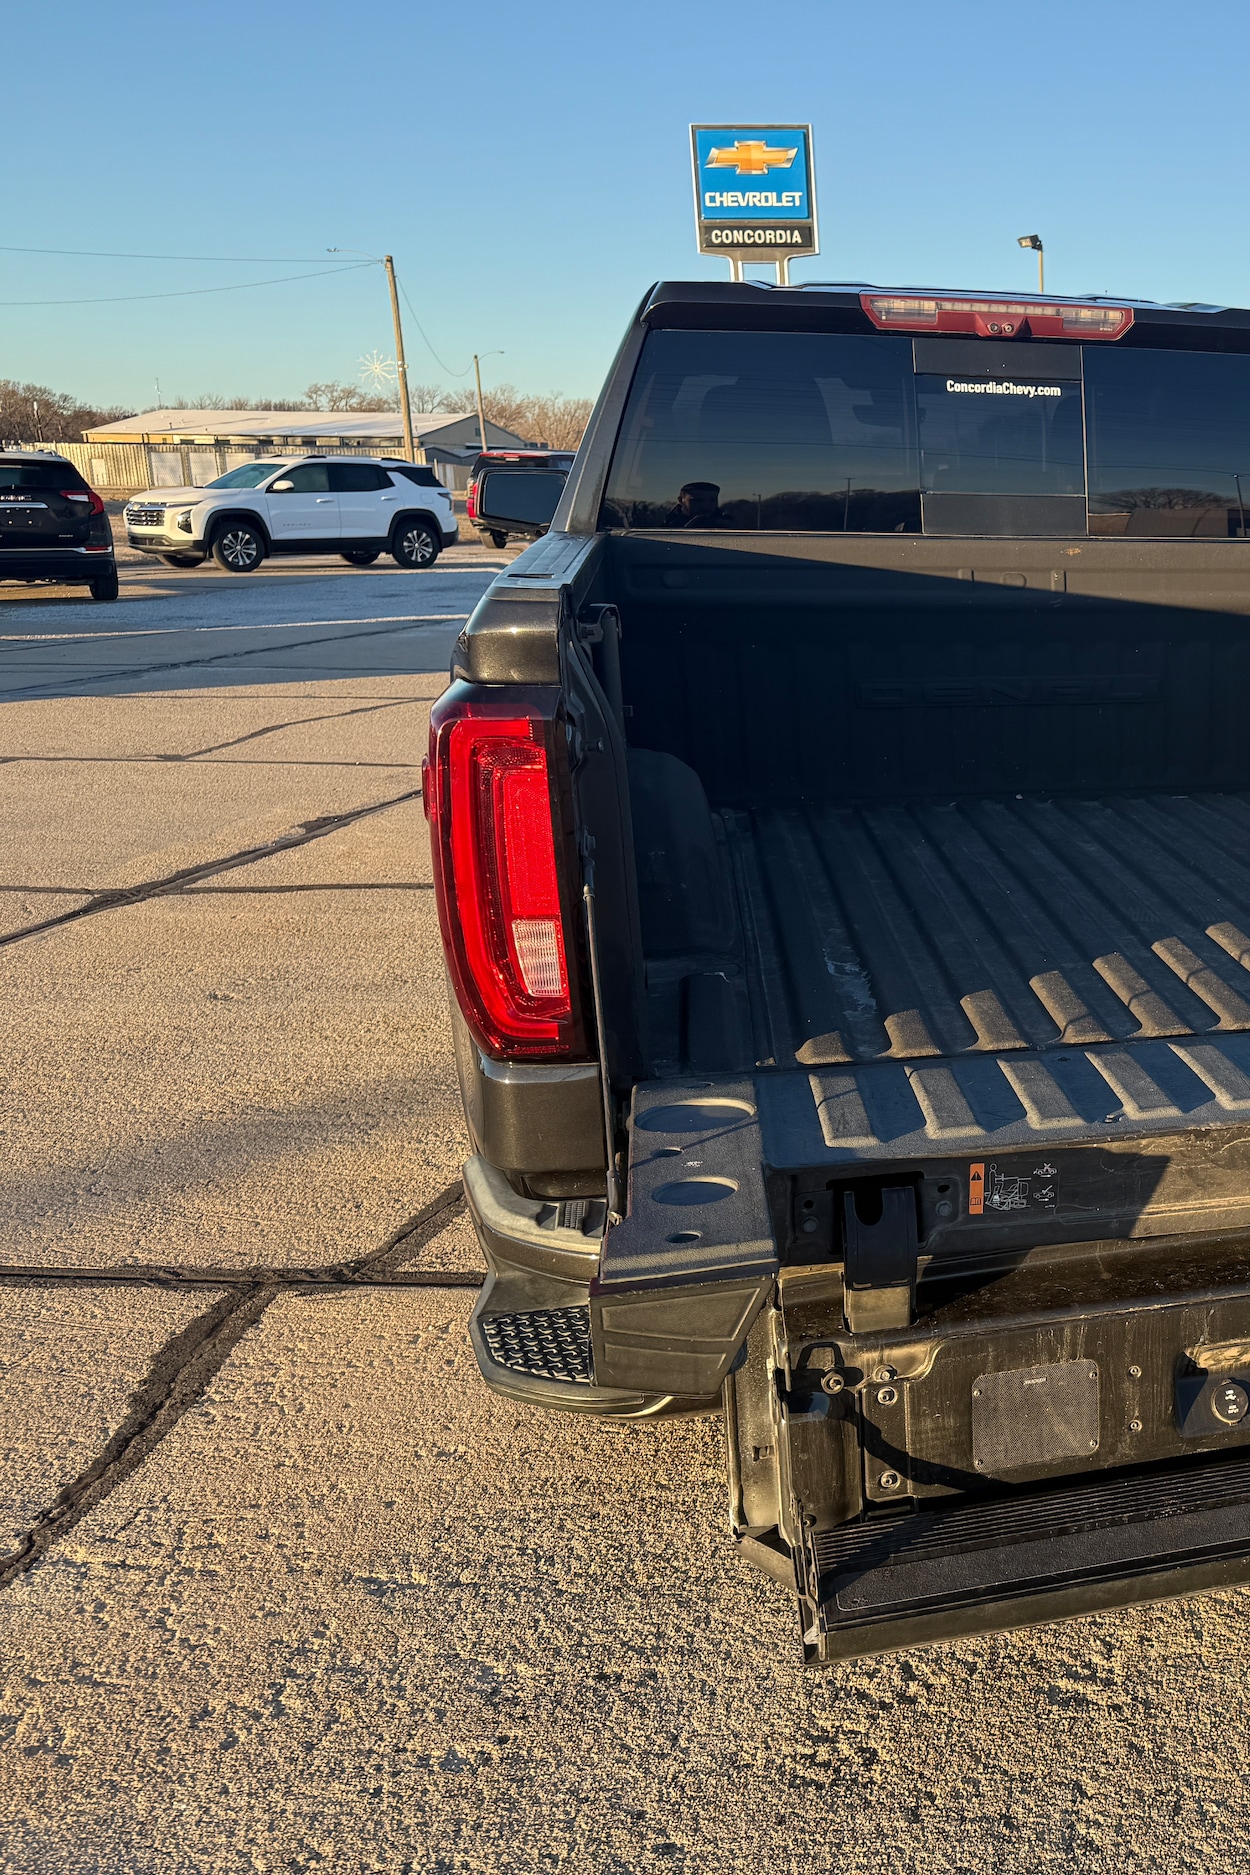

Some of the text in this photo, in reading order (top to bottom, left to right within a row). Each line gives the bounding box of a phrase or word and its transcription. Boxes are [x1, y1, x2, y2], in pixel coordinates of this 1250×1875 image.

[704, 191, 803, 207] CHEVROLET
[711, 229, 803, 244] CONCORDIA
[946, 379, 1062, 398] ConcordiaChevy.com
